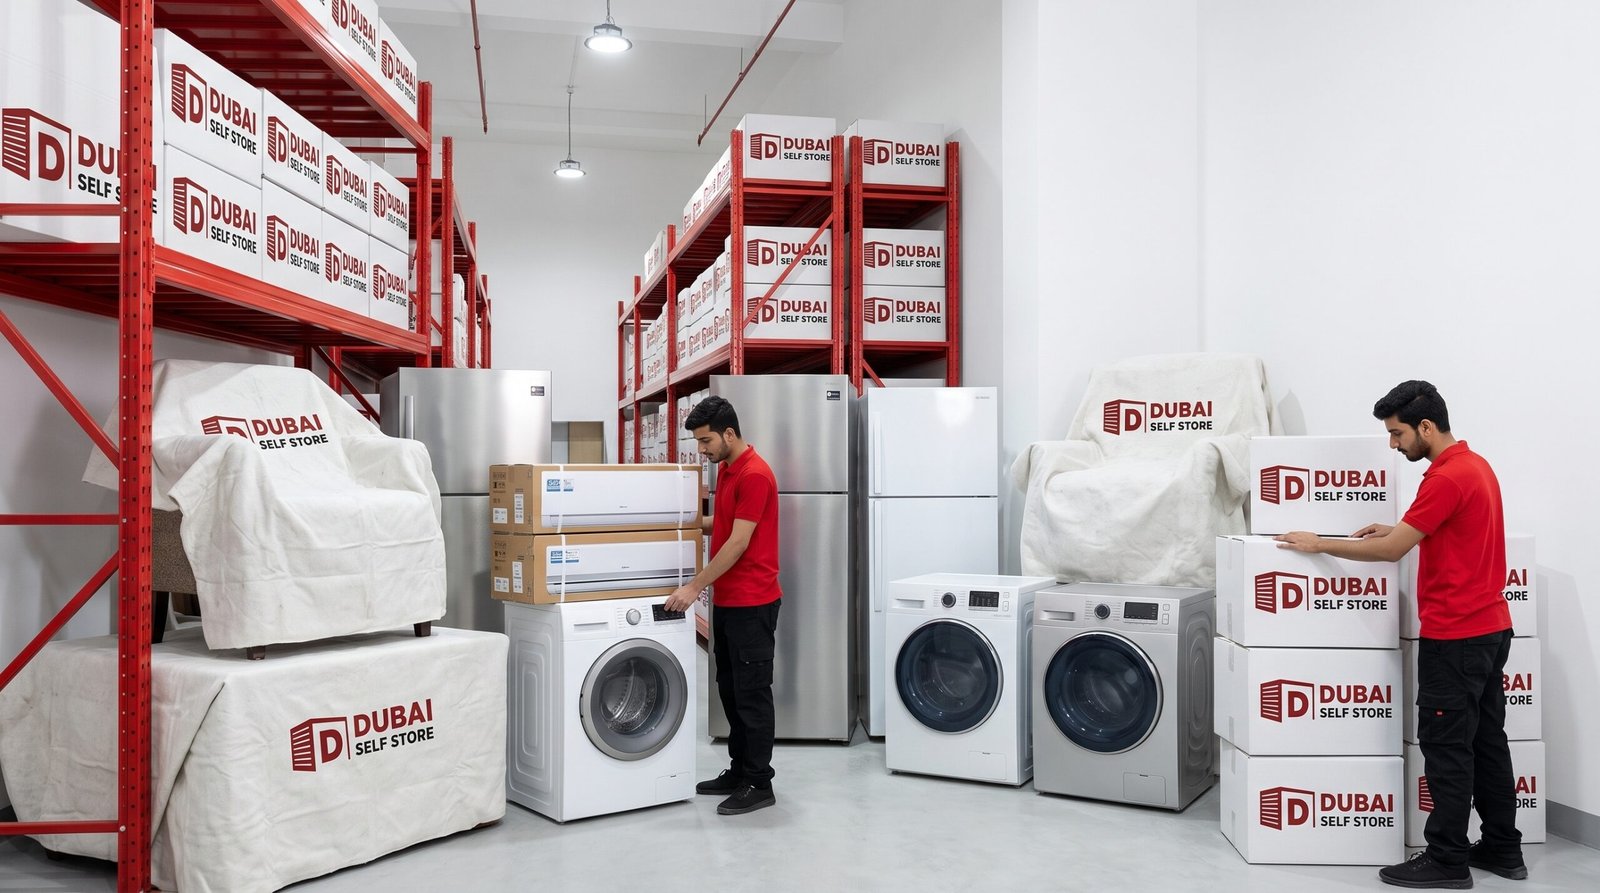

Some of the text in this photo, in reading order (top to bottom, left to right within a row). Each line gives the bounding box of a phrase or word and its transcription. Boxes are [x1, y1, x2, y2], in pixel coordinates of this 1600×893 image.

[352, 3, 376, 47] DUBAI
[396, 57, 415, 92] DUBAI
[210, 87, 256, 135] DUBAI
[210, 119, 256, 155] SELF STORE
[784, 138, 829, 151] DUBAI
[290, 133, 319, 168] DUBAI
[784, 152, 830, 161] SELF STORE
[896, 143, 939, 156] DUBAI
[290, 158, 320, 184] SELF STORE
[78, 173, 112, 198] SELF
[344, 168, 367, 198] DUBAI
[211, 195, 256, 235] DUBAI
[388, 193, 407, 219] DUBAI
[211, 226, 256, 254] SELF STORE
[290, 228, 319, 259] DUBAI
[896, 245, 940, 258] DUBAI
[290, 254, 319, 274] SELF STORE
[343, 253, 366, 278] DUBAI
[388, 273, 406, 295] DUBAI
[781, 301, 827, 313] DUBAI
[896, 301, 940, 313] DUBAI
[1151, 401, 1212, 418] DUBAI
[251, 414, 322, 436] DUBAI
[1150, 421, 1212, 431] SELF STORE
[259, 434, 328, 450] SELF STORE
[1315, 470, 1385, 487] DUBAI
[1315, 492, 1386, 501] SELF STORE
[1314, 577, 1387, 596] DUBAI
[1502, 591, 1528, 601] ORE
[1314, 600, 1387, 610] SELF STORE
[1503, 674, 1531, 691] BAI
[1320, 685, 1391, 703] DUBAI
[354, 699, 432, 738] DUBAI
[1320, 708, 1392, 718] SELF STORE
[356, 727, 434, 755] SELF STORE
[1321, 794, 1393, 812] DUBAI
[1321, 816, 1394, 827] SELF STORE
